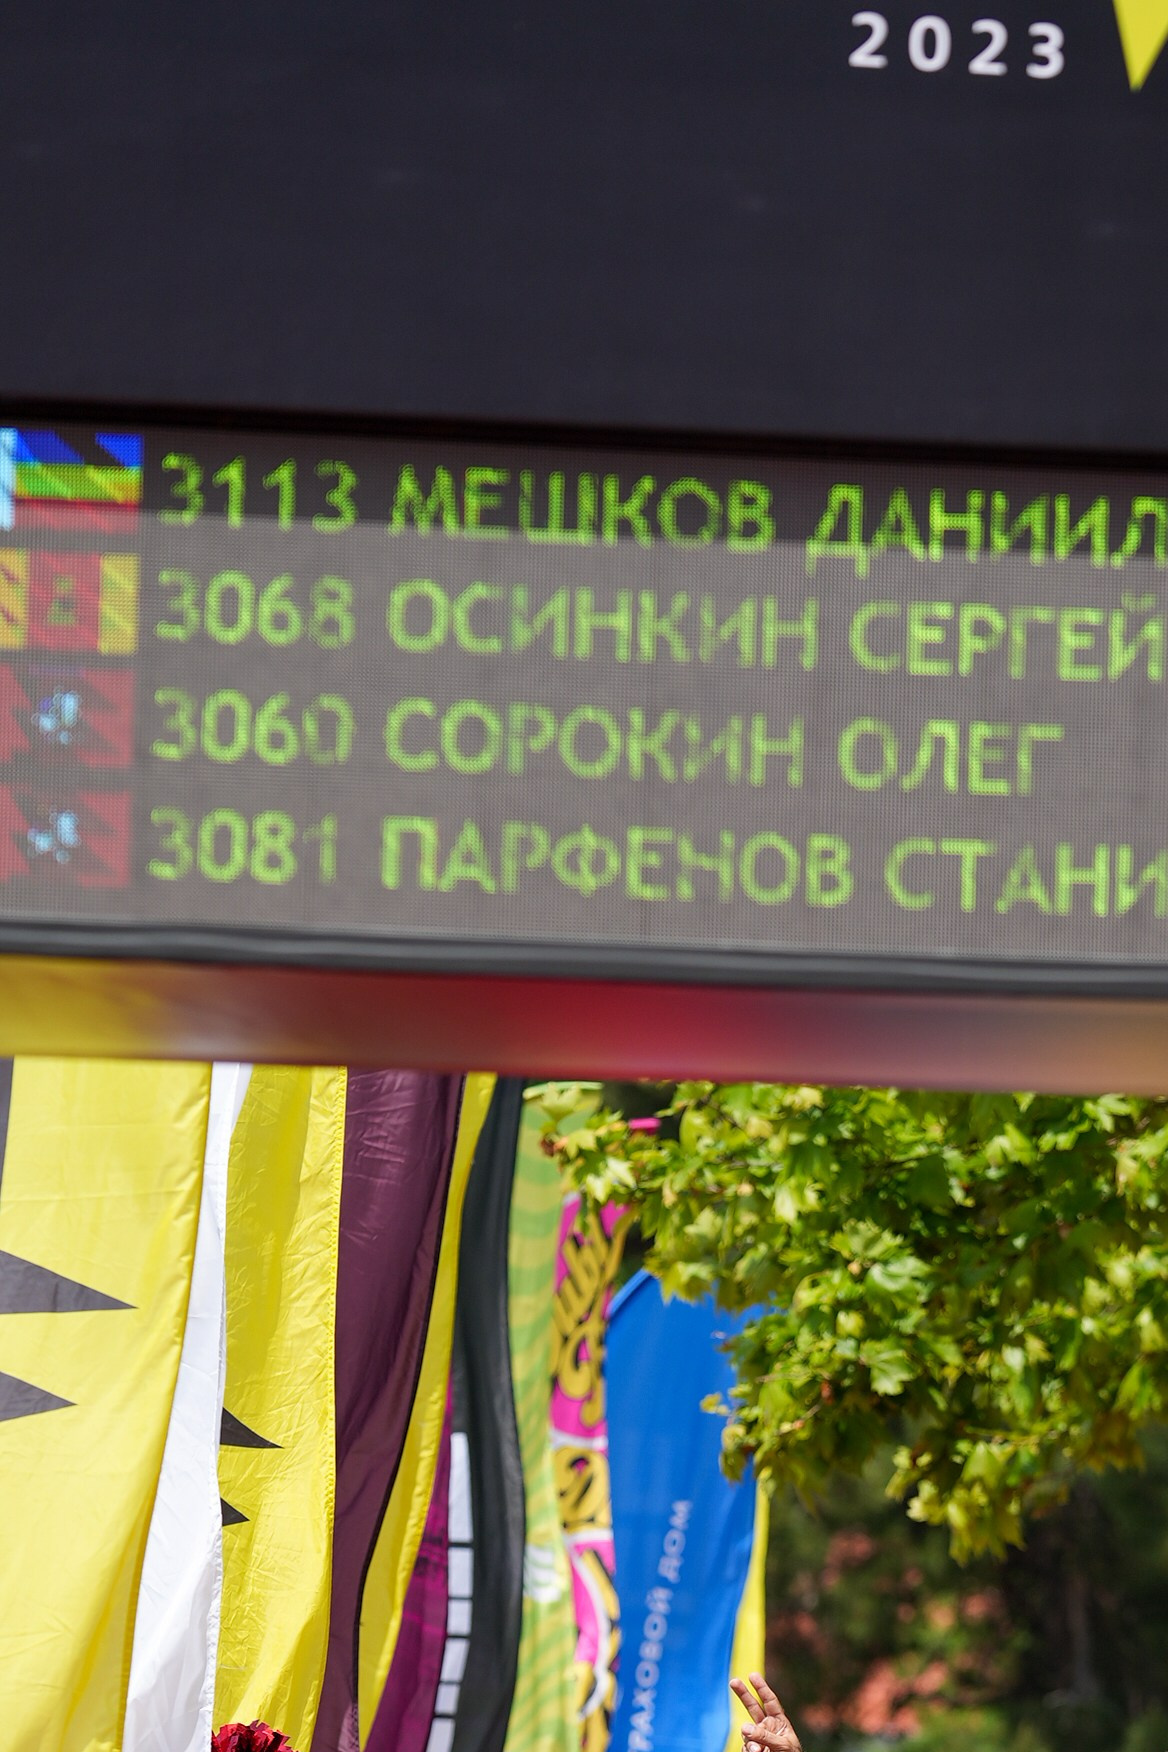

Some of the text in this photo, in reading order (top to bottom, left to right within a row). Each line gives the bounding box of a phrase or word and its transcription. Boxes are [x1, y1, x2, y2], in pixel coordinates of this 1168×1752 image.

[848, 11, 1064, 79] 2023
[160, 452, 358, 533] 3113
[389, 465, 776, 553] МЕШКОВ
[155, 569, 355, 647] 3068
[388, 577, 819, 671] ОСИНКИН
[850, 594, 1165, 682] СЕРГЕЙ
[152, 688, 354, 766] 3060
[385, 697, 804, 787] СОРОКИН
[838, 715, 1064, 796] ОЛЕГ
[149, 807, 338, 886] 3081
[380, 815, 854, 910] ПАРФЕНОВ
[656, 1499, 693, 1585] ДОМ
